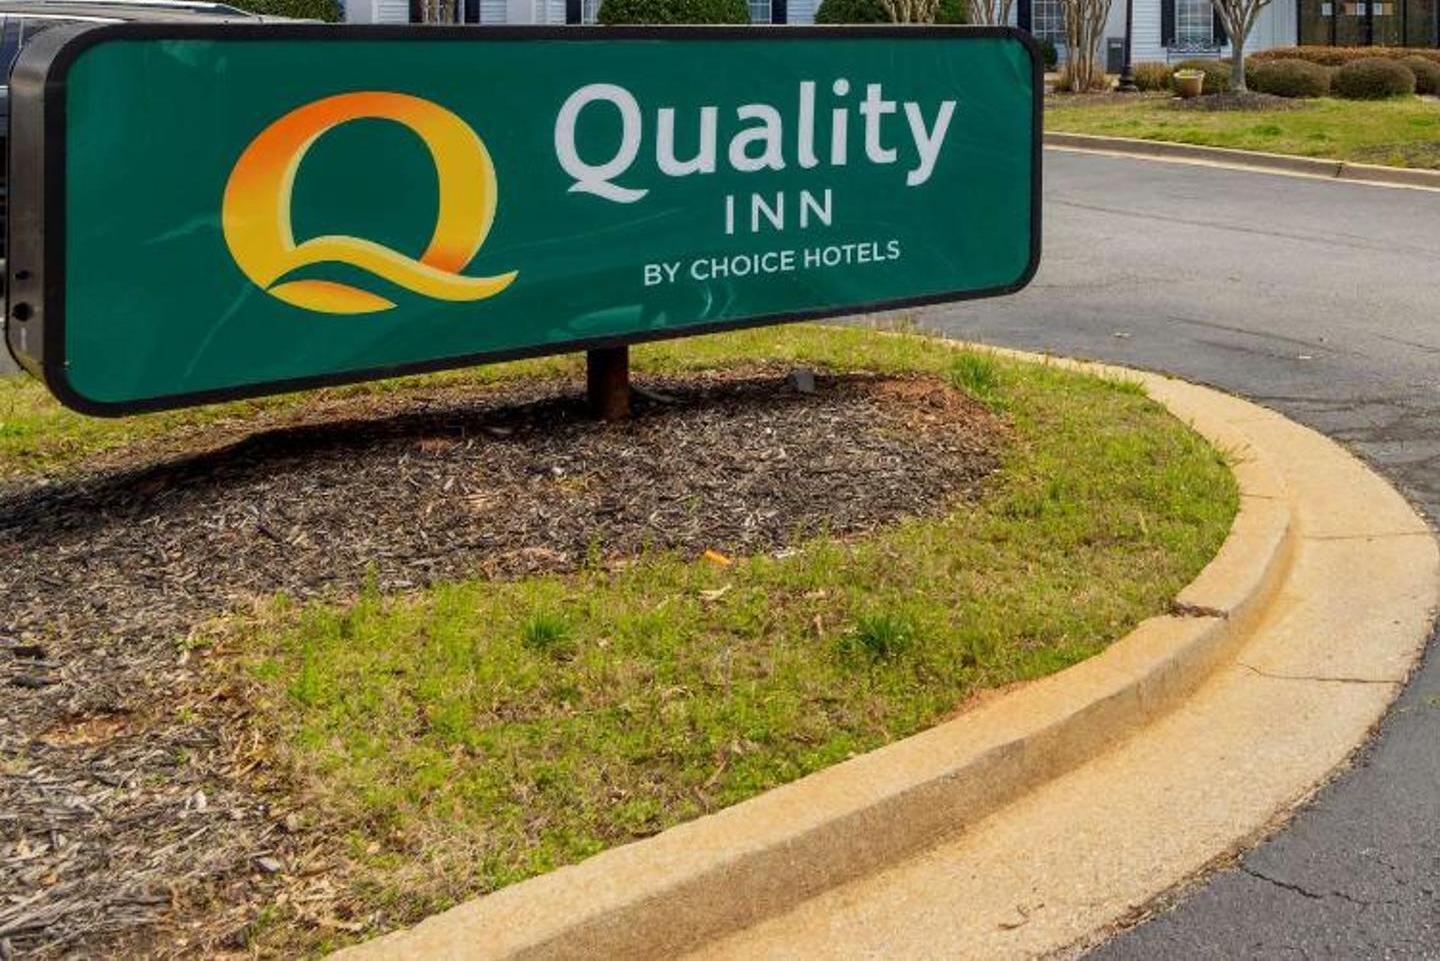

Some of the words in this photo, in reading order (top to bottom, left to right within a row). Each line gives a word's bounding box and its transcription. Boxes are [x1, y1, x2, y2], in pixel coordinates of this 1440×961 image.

[221, 90, 518, 314] Q
[553, 78, 957, 204] Quality
[725, 188, 833, 235] INN
[642, 261, 682, 287] BY
[689, 250, 796, 281] CHOICE
[803, 239, 901, 270] HOTELS
